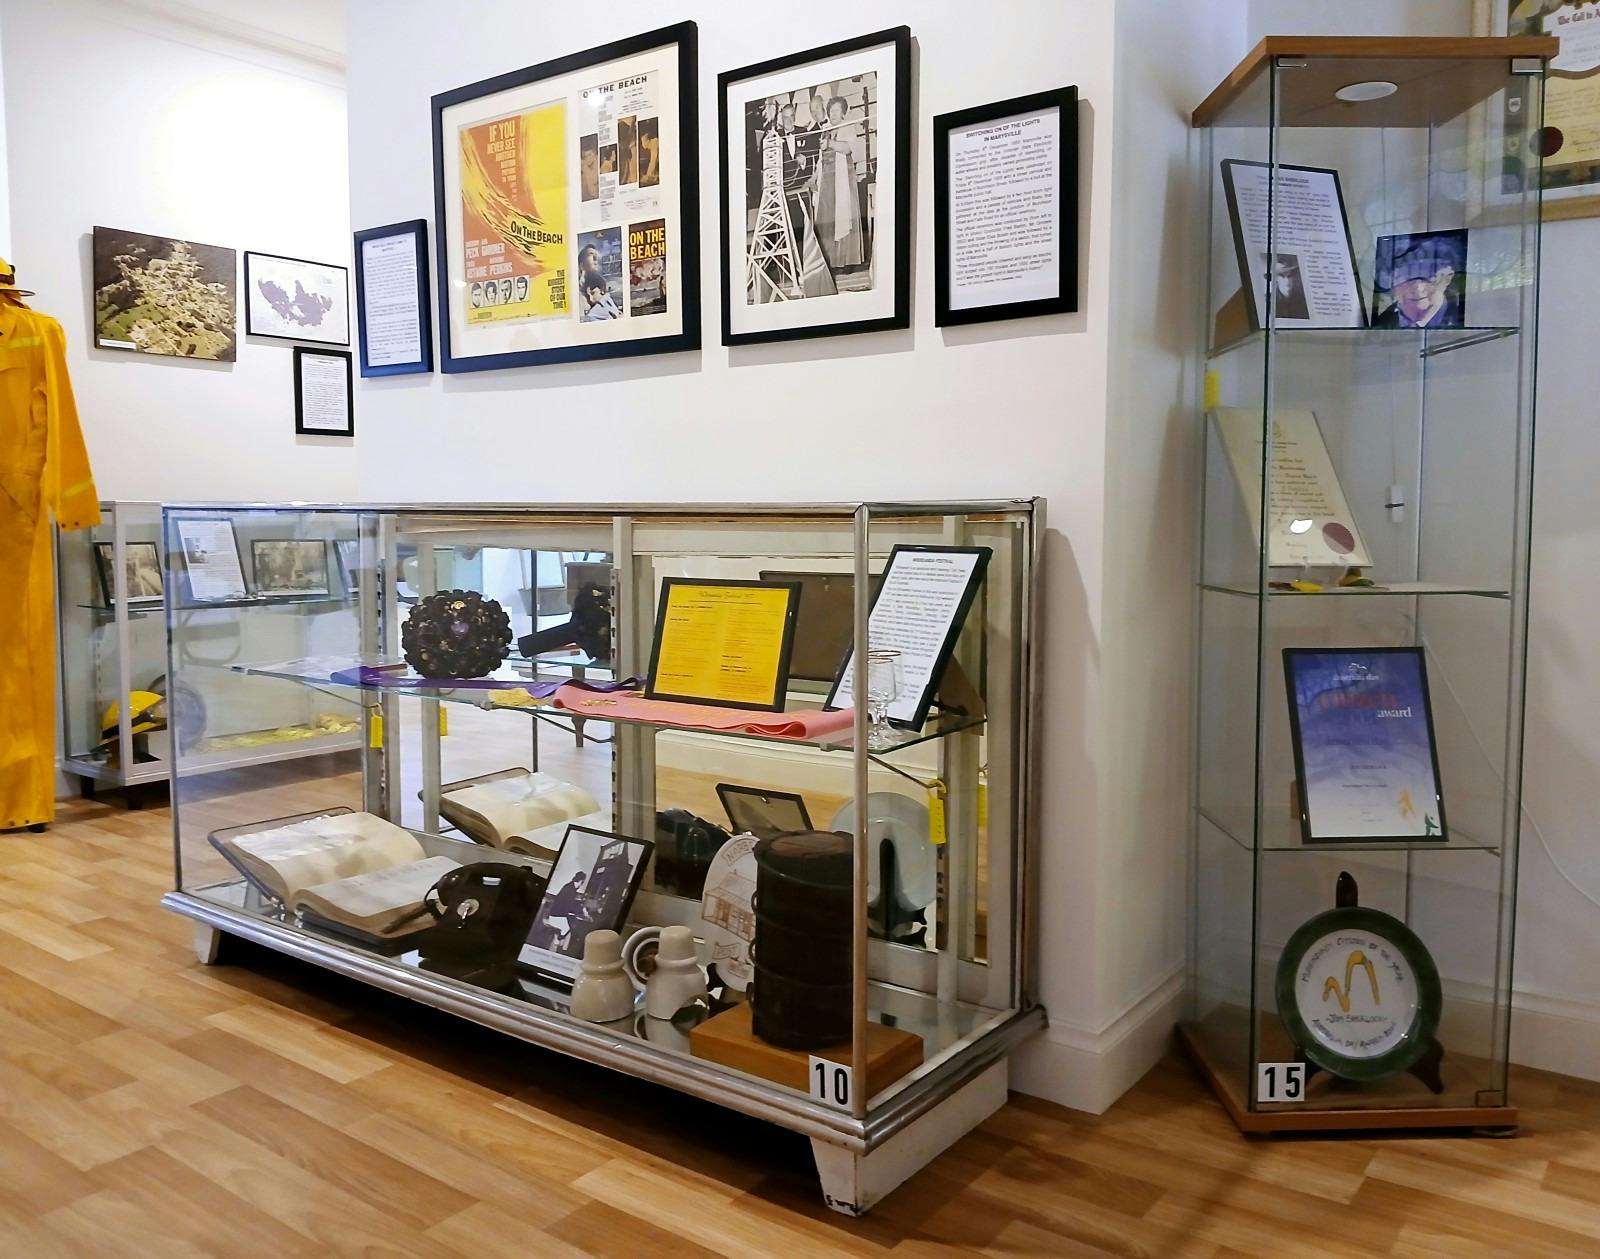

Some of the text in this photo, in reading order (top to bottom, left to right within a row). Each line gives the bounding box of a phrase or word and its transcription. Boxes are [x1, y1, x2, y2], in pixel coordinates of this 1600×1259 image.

[598, 84, 614, 94] THE
[618, 76, 647, 89] BEACH
[489, 120, 515, 142] IF YOU
[511, 221, 562, 244] ON THE BEACH
[630, 228, 664, 246] ON THE
[630, 242, 665, 260] BEACH
[1377, 706, 1412, 718] award
[815, 1062, 848, 1105] 10
[1265, 1067, 1300, 1098] 15
